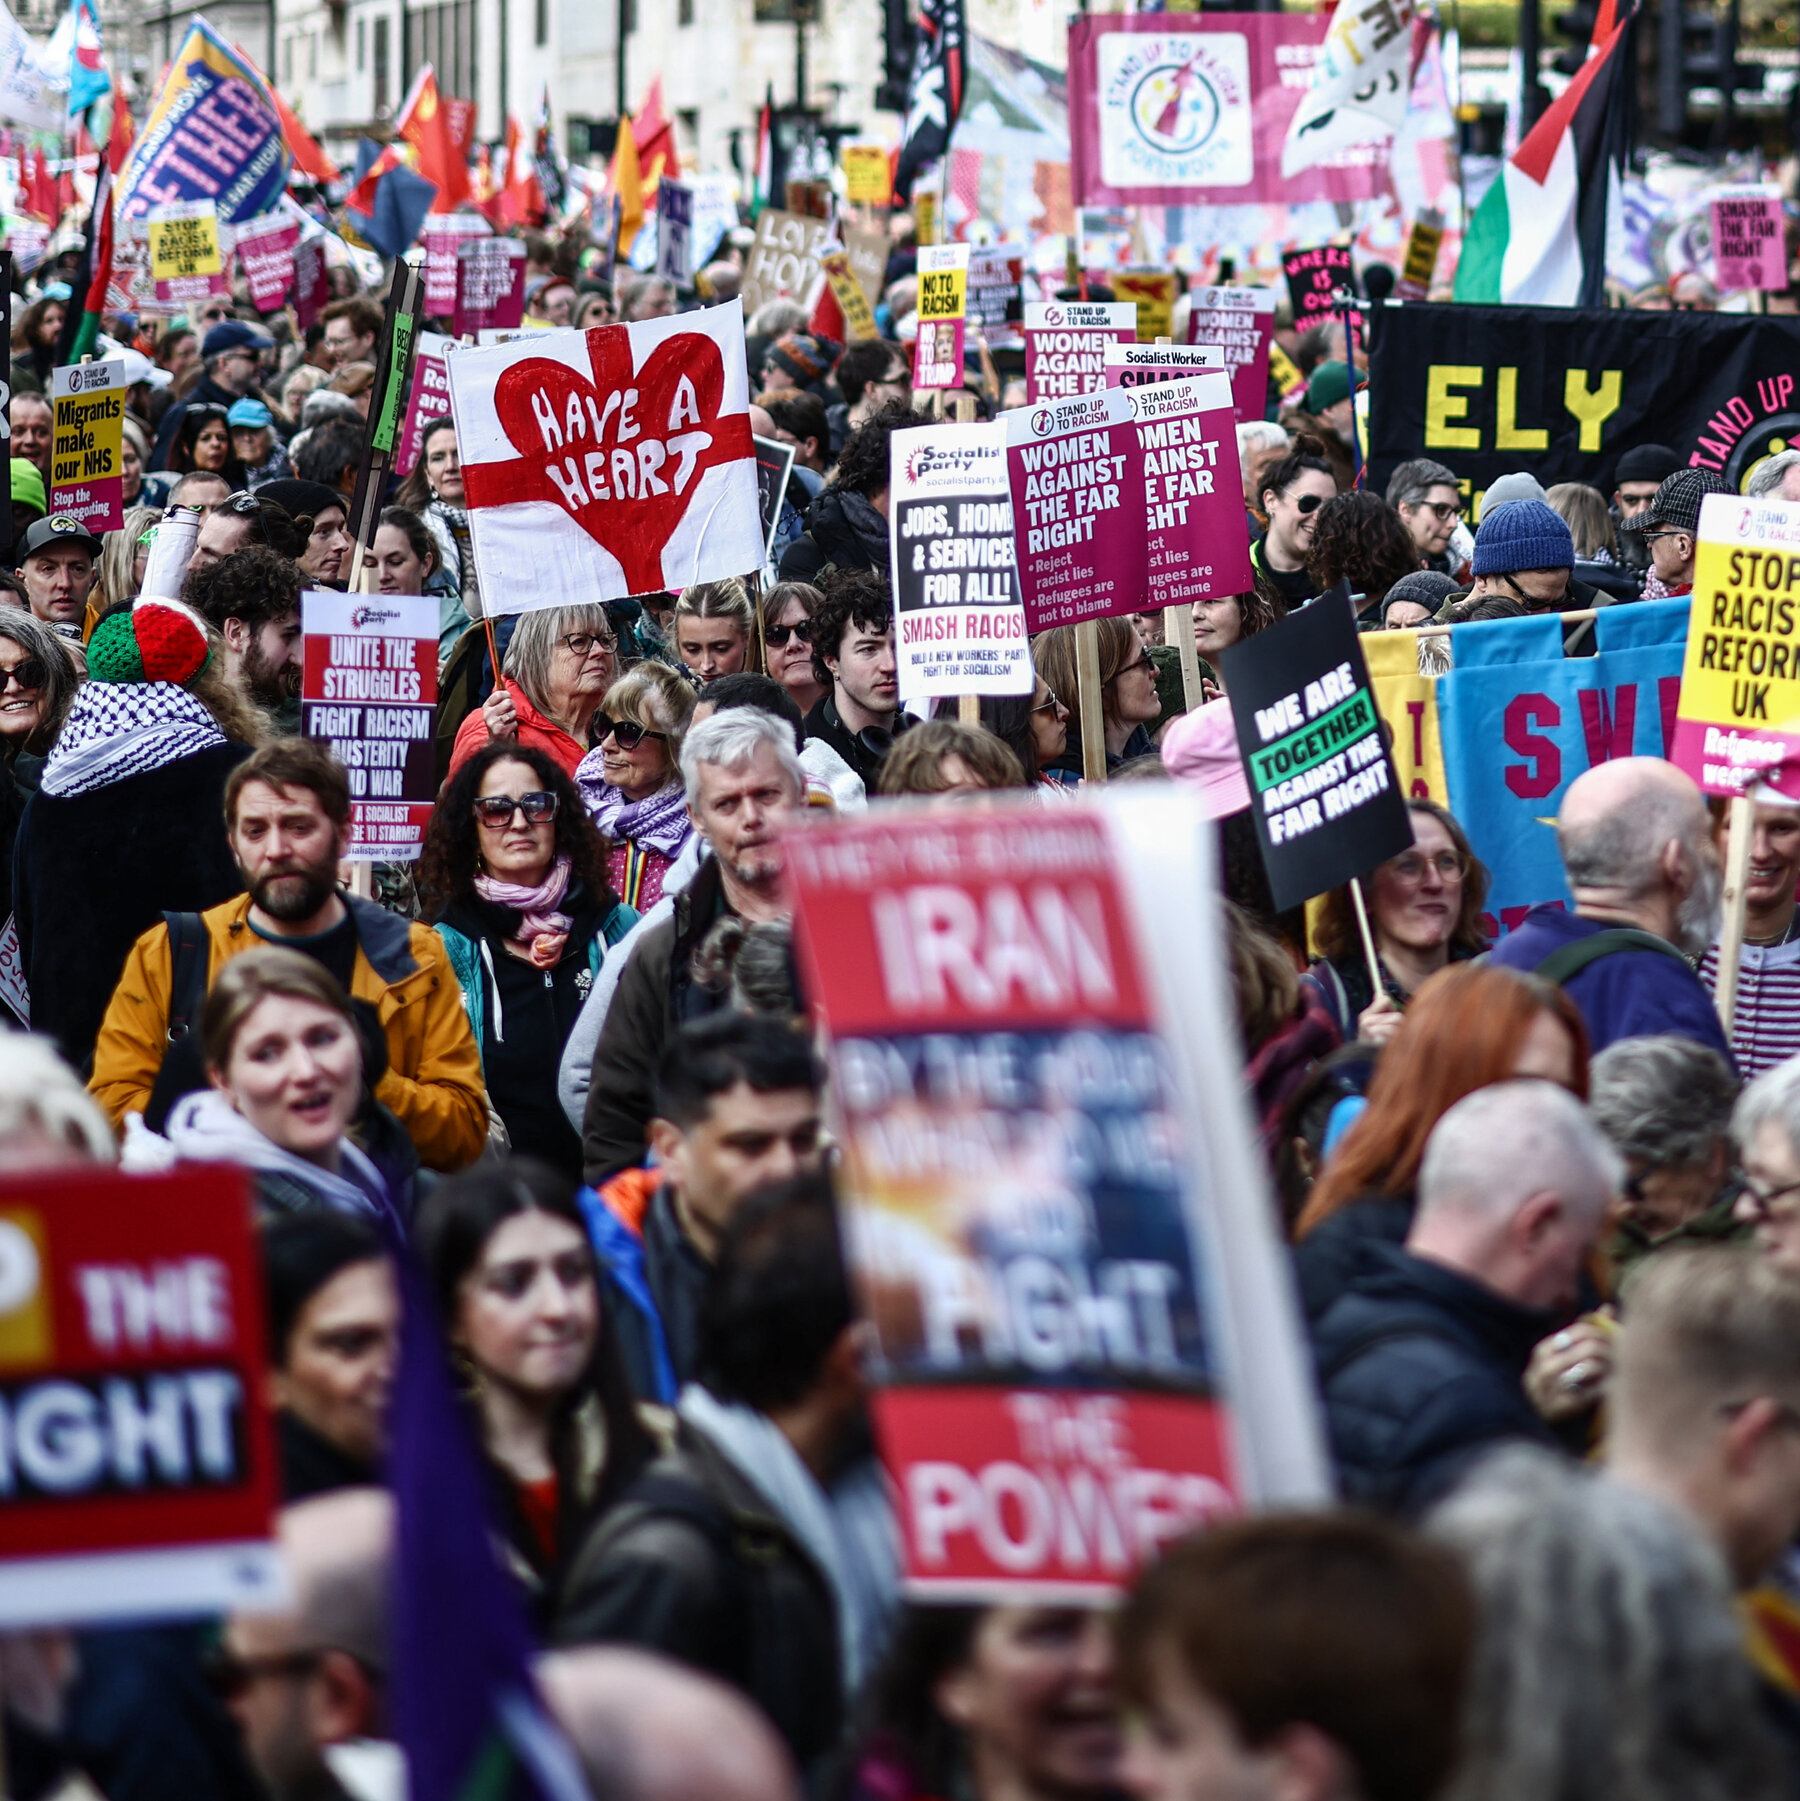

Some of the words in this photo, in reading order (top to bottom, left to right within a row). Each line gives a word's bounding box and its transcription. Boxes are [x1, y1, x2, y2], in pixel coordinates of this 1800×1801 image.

[1716, 201, 1768, 218] SMASH
[164, 219, 201, 233] STOP
[1719, 220, 1744, 238] THE
[1748, 220, 1776, 237] FAR
[159, 230, 209, 248] RACIST
[1720, 240, 1762, 257] RIGHT
[464, 256, 510, 270] WOMEN
[1285, 247, 1350, 276] WHERE
[923, 275, 936, 294] NO
[938, 273, 954, 293] TO
[1312, 269, 1332, 290] IS
[922, 294, 959, 315] RACISM
[1067, 307, 1094, 316] STAND
[1095, 307, 1106, 316] UP
[1303, 292, 1333, 311] OU
[1067, 316, 1079, 326] TO
[1080, 316, 1111, 326] RACISM
[1197, 311, 1255, 329] WOMEN
[920, 322, 936, 344] NO
[1195, 328, 1262, 347] AGAINST
[919, 343, 935, 365] TO
[1034, 354, 1106, 374] AGAIN
[1126, 351, 1171, 364] Socialist
[1172, 352, 1207, 365] Worker
[1225, 346, 1255, 364] FAR
[84, 369, 100, 380] STAND
[100, 367, 107, 377] UP
[84, 379, 91, 389] TO
[91, 377, 110, 388] RACISM
[917, 362, 957, 386] TRUMP
[1034, 375, 1081, 395] THE
[1140, 389, 1175, 404] STAND
[1177, 386, 1192, 398] UP
[57, 396, 121, 429] Migrants
[418, 393, 449, 413] are
[531, 387, 641, 452] HAVE
[668, 373, 701, 431] A
[1056, 403, 1088, 419] STAND
[1089, 399, 1104, 413] UP
[1142, 404, 1156, 416] TO
[1159, 397, 1199, 414] RACISM
[1424, 365, 1624, 452] ELY
[1057, 418, 1071, 430] TO
[1071, 411, 1110, 428] RACISM
[1688, 396, 1755, 470] TAND
[1756, 374, 1794, 413] UP
[56, 428, 95, 455] make
[1020, 430, 1111, 473] WOMEN
[55, 458, 80, 481] our
[84, 448, 112, 477] NHS
[1144, 440, 1220, 477] AINST
[545, 430, 714, 511] HEART
[1025, 454, 1127, 501] AGAINST
[1164, 469, 1215, 500] FAR
[53, 490, 75, 508] Stop
[75, 488, 91, 502] the
[1025, 494, 1070, 526] THE
[1075, 484, 1121, 516] FAR
[901, 504, 955, 537] JOBS,
[1027, 515, 1096, 554] RIGHT
[912, 545, 926, 571] &
[1035, 552, 1073, 574] Reject
[1165, 550, 1190, 564] lies
[1036, 571, 1071, 590] racist
[1072, 565, 1095, 582] lies
[1190, 565, 1213, 579] are
[1728, 550, 1800, 592] STOP
[923, 573, 961, 606] FOR
[965, 572, 1012, 604] ALL!
[1037, 585, 1093, 609] Refugees
[1094, 579, 1115, 593] are
[1154, 588, 1167, 601] to
[1170, 581, 1212, 600] blame
[1038, 607, 1058, 624] not
[1060, 604, 1074, 617] to
[1075, 597, 1113, 615] blame
[1710, 592, 1800, 636] RACIS
[902, 614, 958, 645] SMASH
[330, 635, 380, 667] UNITE
[384, 638, 417, 669] THE
[935, 651, 954, 663] NEW
[923, 666, 942, 678] FIGHT
[945, 665, 961, 677] FOR
[963, 664, 1012, 677] SOCIALISM
[323, 668, 421, 701] STRUGGLES
[1254, 693, 1305, 743] WE
[1303, 661, 1357, 719] ARE
[1731, 679, 1771, 720] UK
[310, 706, 362, 737] FIGHT
[365, 708, 430, 739] RACISM
[1259, 697, 1369, 781] TOGETHER
[348, 769, 367, 796] ND
[371, 770, 403, 797] WAR
[1263, 752, 1348, 815] AGAINST
[1346, 732, 1384, 772] THE
[1266, 798, 1324, 846] FAR
[1321, 758, 1390, 822] RIGHT
[355, 806, 364, 823] A
[365, 806, 410, 823] SOCIALIST
[367, 825, 377, 841] TO
[378, 825, 421, 842] STARMER
[869, 880, 1119, 1013] IRAN
[78, 1254, 231, 1348] THE
